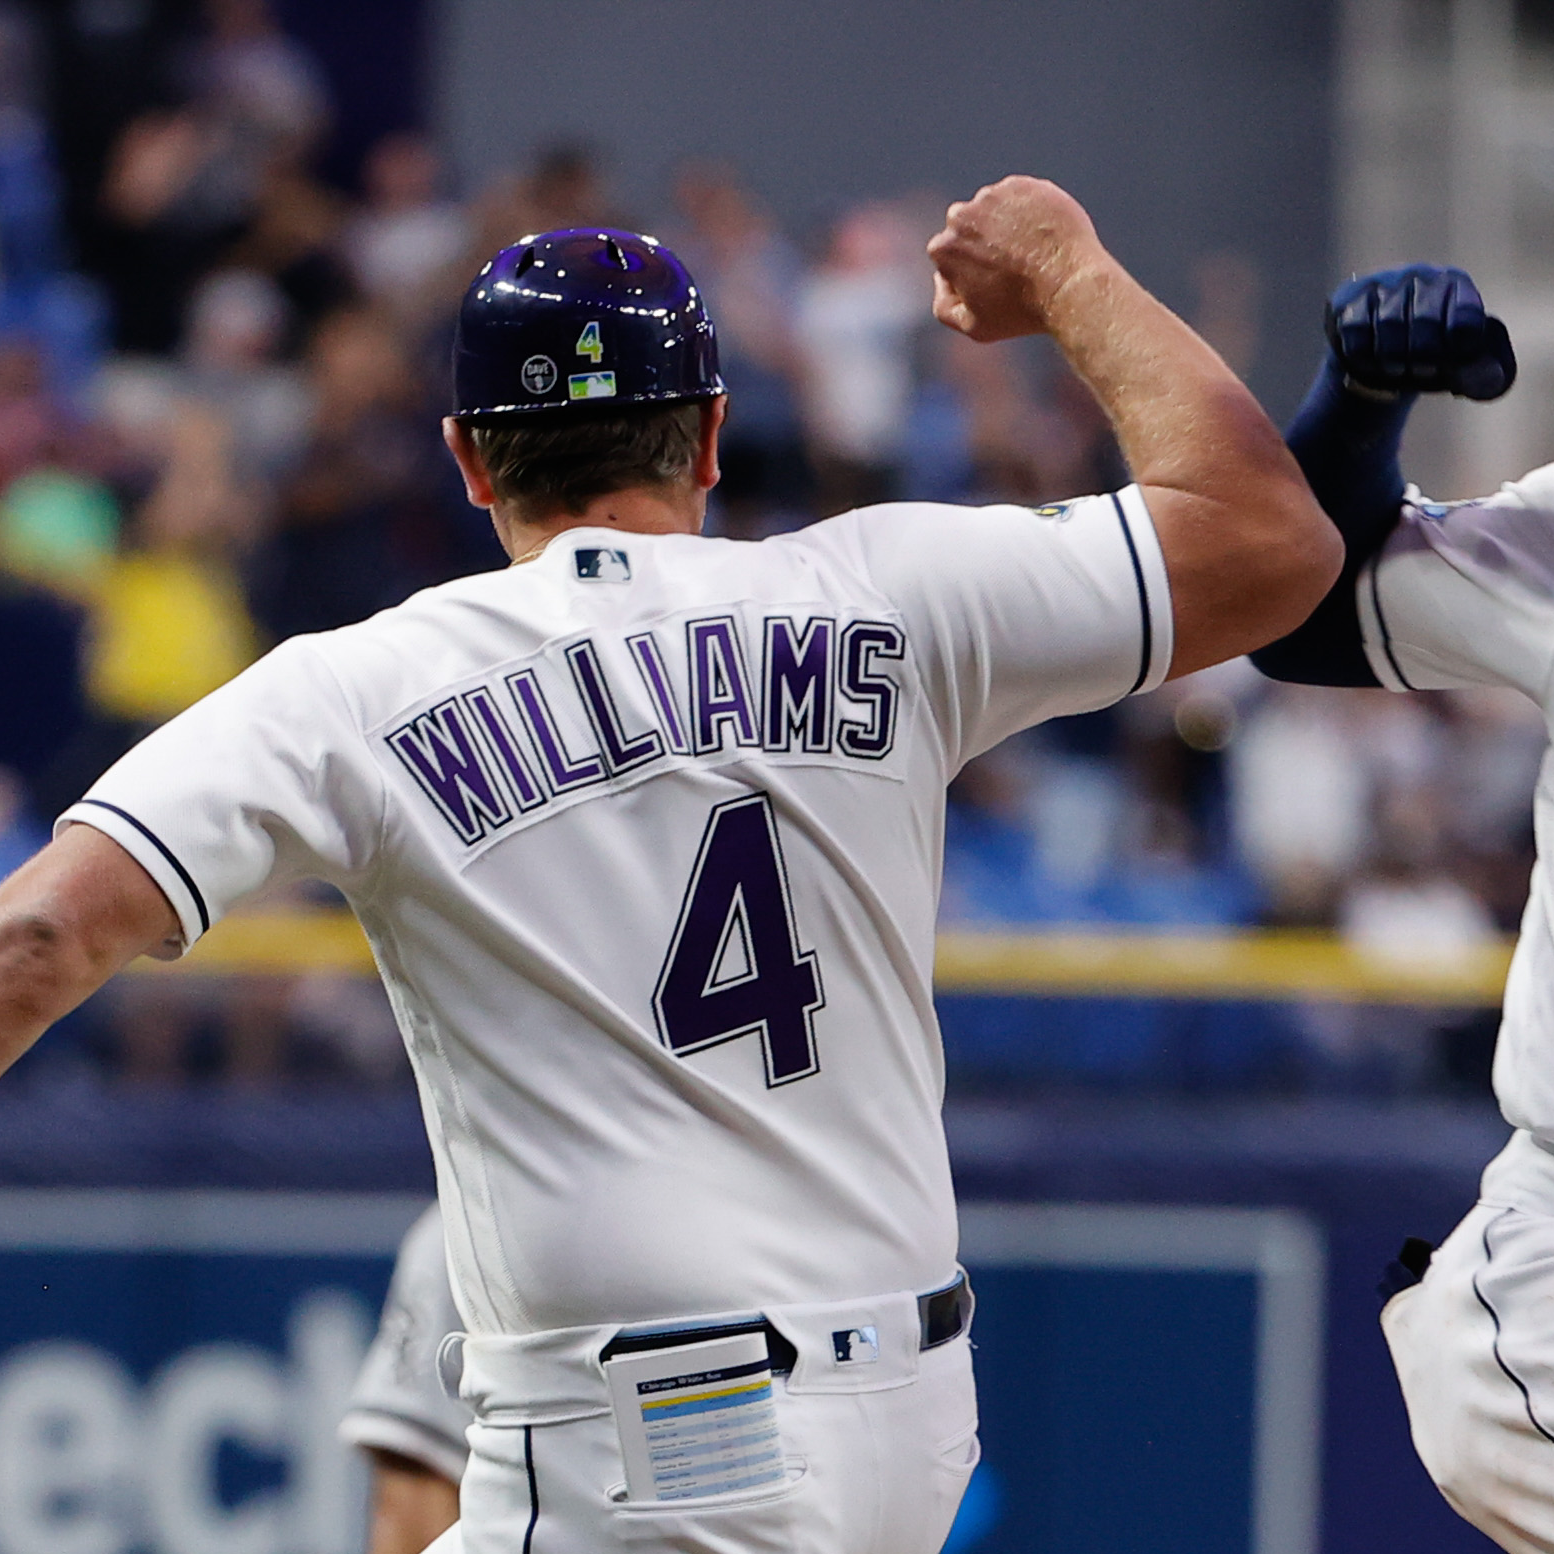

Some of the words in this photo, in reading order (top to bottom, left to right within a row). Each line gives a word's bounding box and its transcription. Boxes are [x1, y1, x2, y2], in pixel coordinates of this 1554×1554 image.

[527, 363, 549, 376] DAVE
[576, 321, 603, 363] 4
[384, 613, 906, 848] WILLIAMS
[652, 790, 825, 1091] 4
